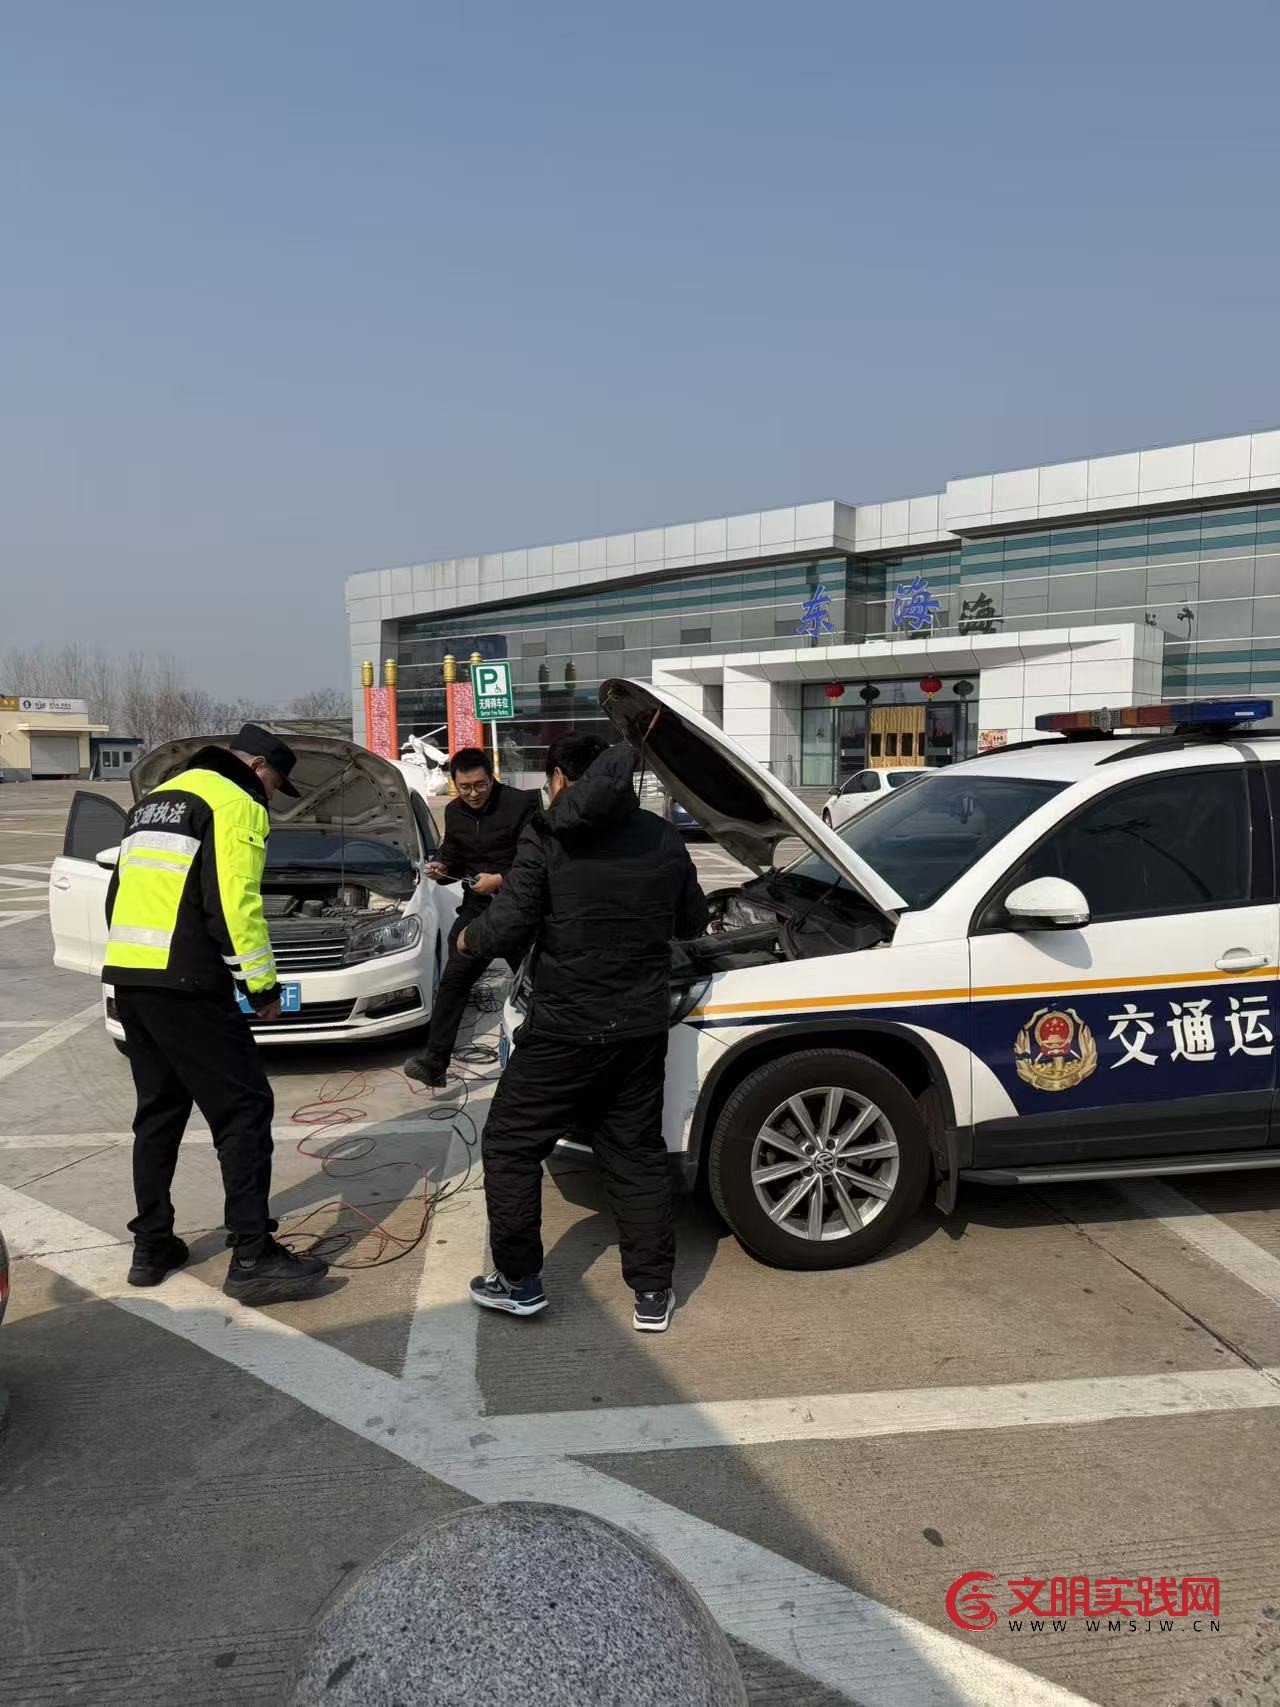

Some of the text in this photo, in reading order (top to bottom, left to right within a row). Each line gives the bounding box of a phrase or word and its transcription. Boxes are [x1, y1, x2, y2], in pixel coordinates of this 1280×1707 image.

[479, 668, 498, 694] P
[130, 801, 187, 829] 交通执法
[1108, 995, 1275, 1069] 交通运
